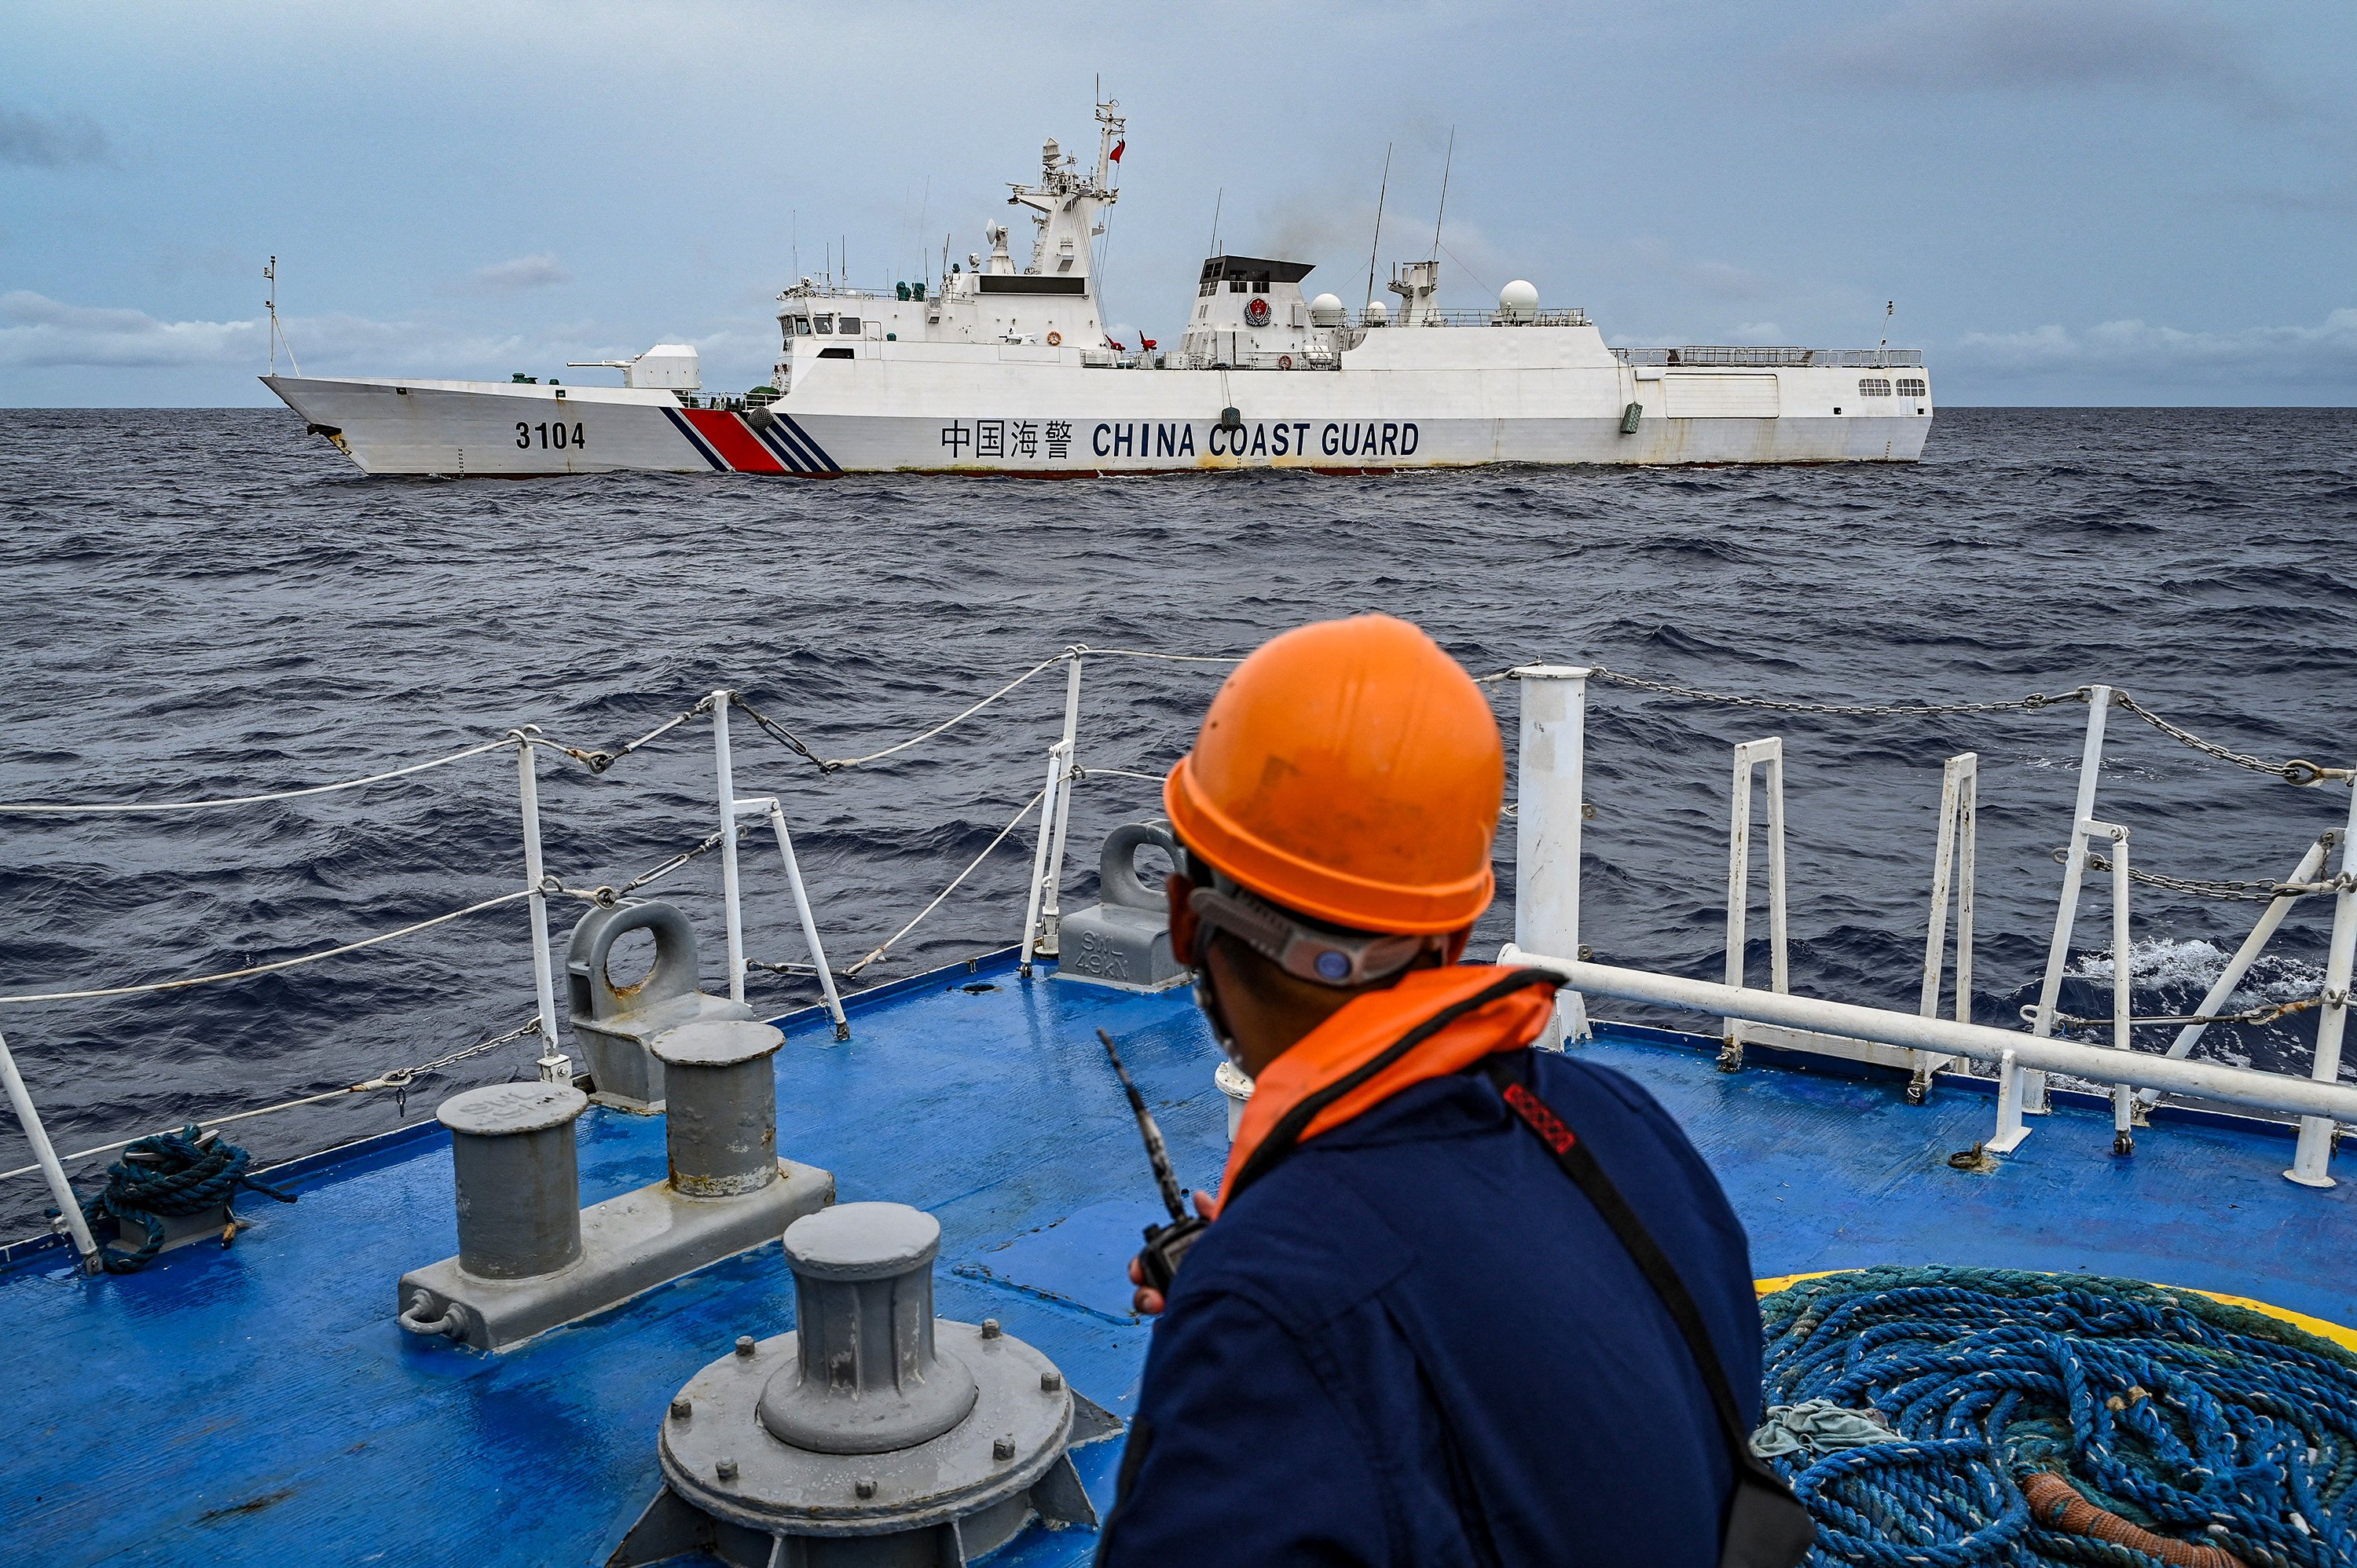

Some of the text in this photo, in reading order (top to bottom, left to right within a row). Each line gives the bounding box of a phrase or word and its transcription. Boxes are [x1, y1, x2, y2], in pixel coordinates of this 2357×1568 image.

[515, 421, 586, 450] 3104
[941, 419, 1072, 460] 中国海警
[1092, 423, 1419, 457] CHINA COAST GUARD
[1082, 930, 1124, 958] SWL
